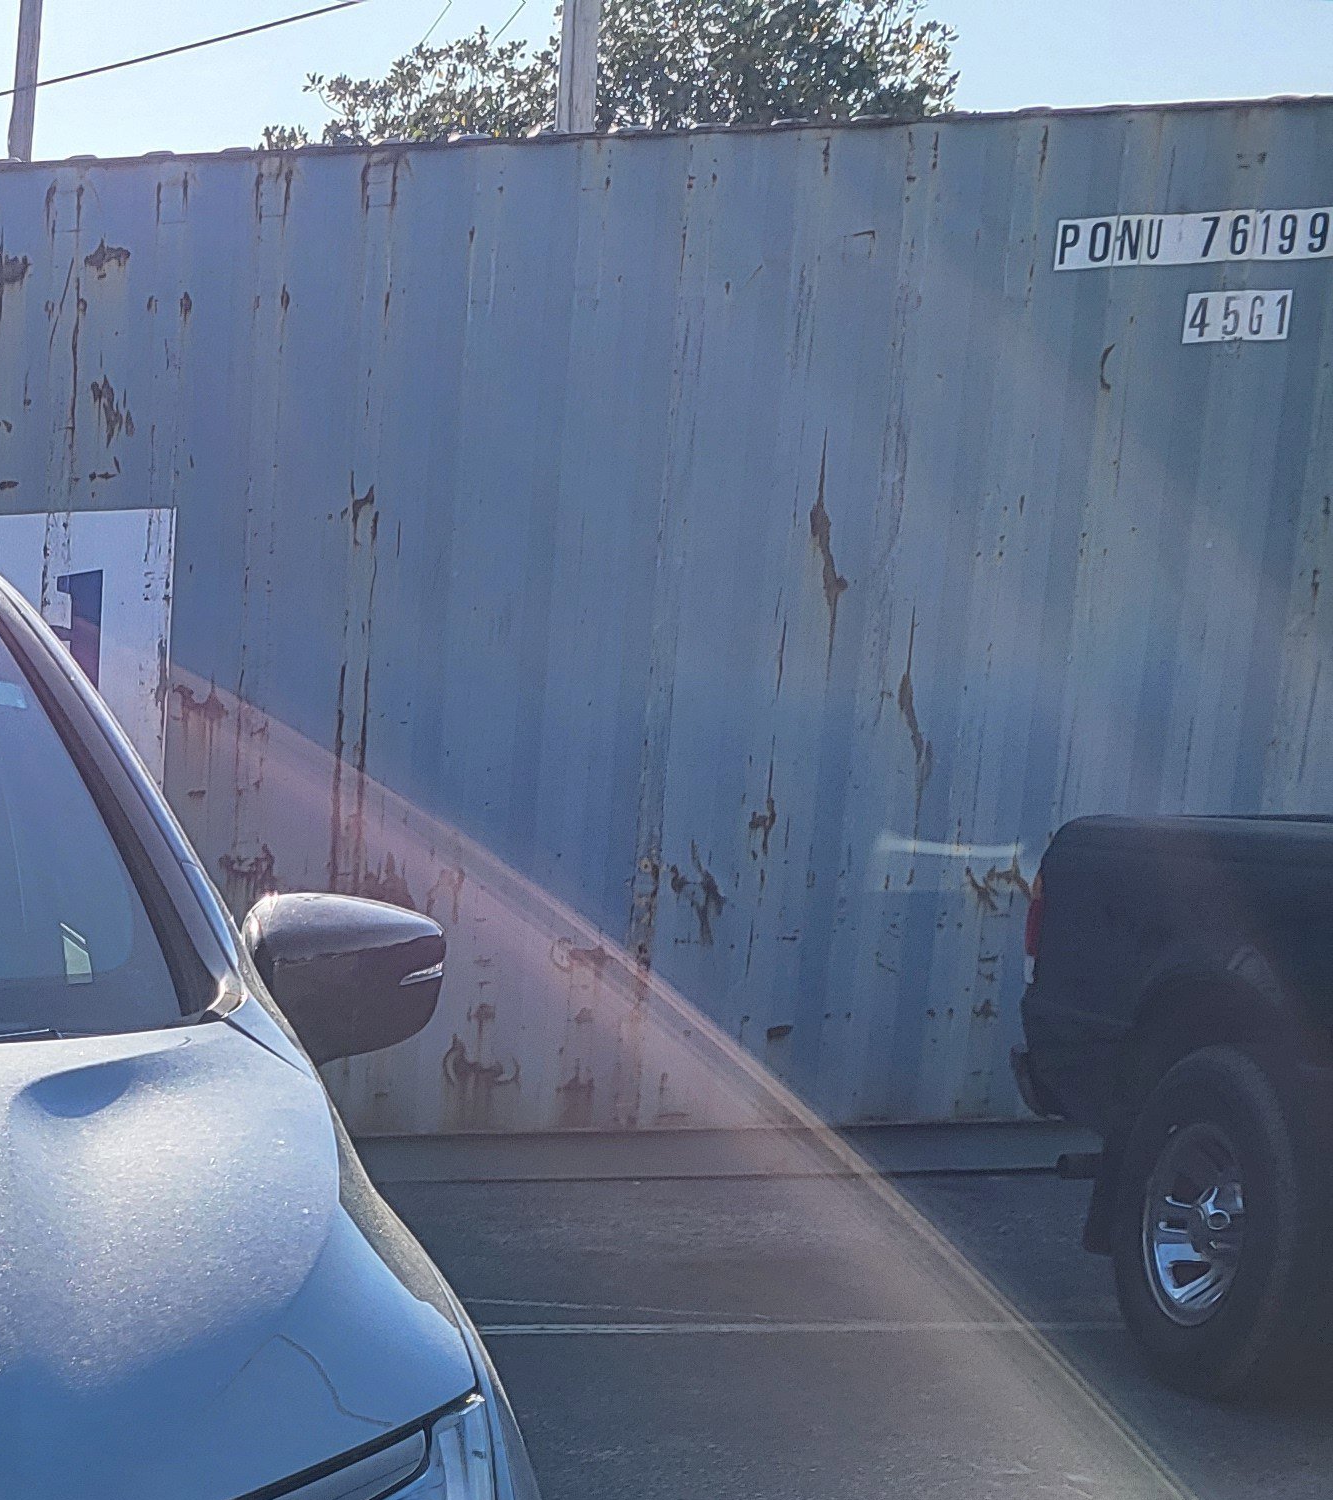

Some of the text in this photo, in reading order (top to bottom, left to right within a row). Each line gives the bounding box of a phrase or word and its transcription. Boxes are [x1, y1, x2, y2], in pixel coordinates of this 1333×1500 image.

[1058, 211, 1330, 265] PONU 76199
[1188, 294, 1288, 337] 45G1
